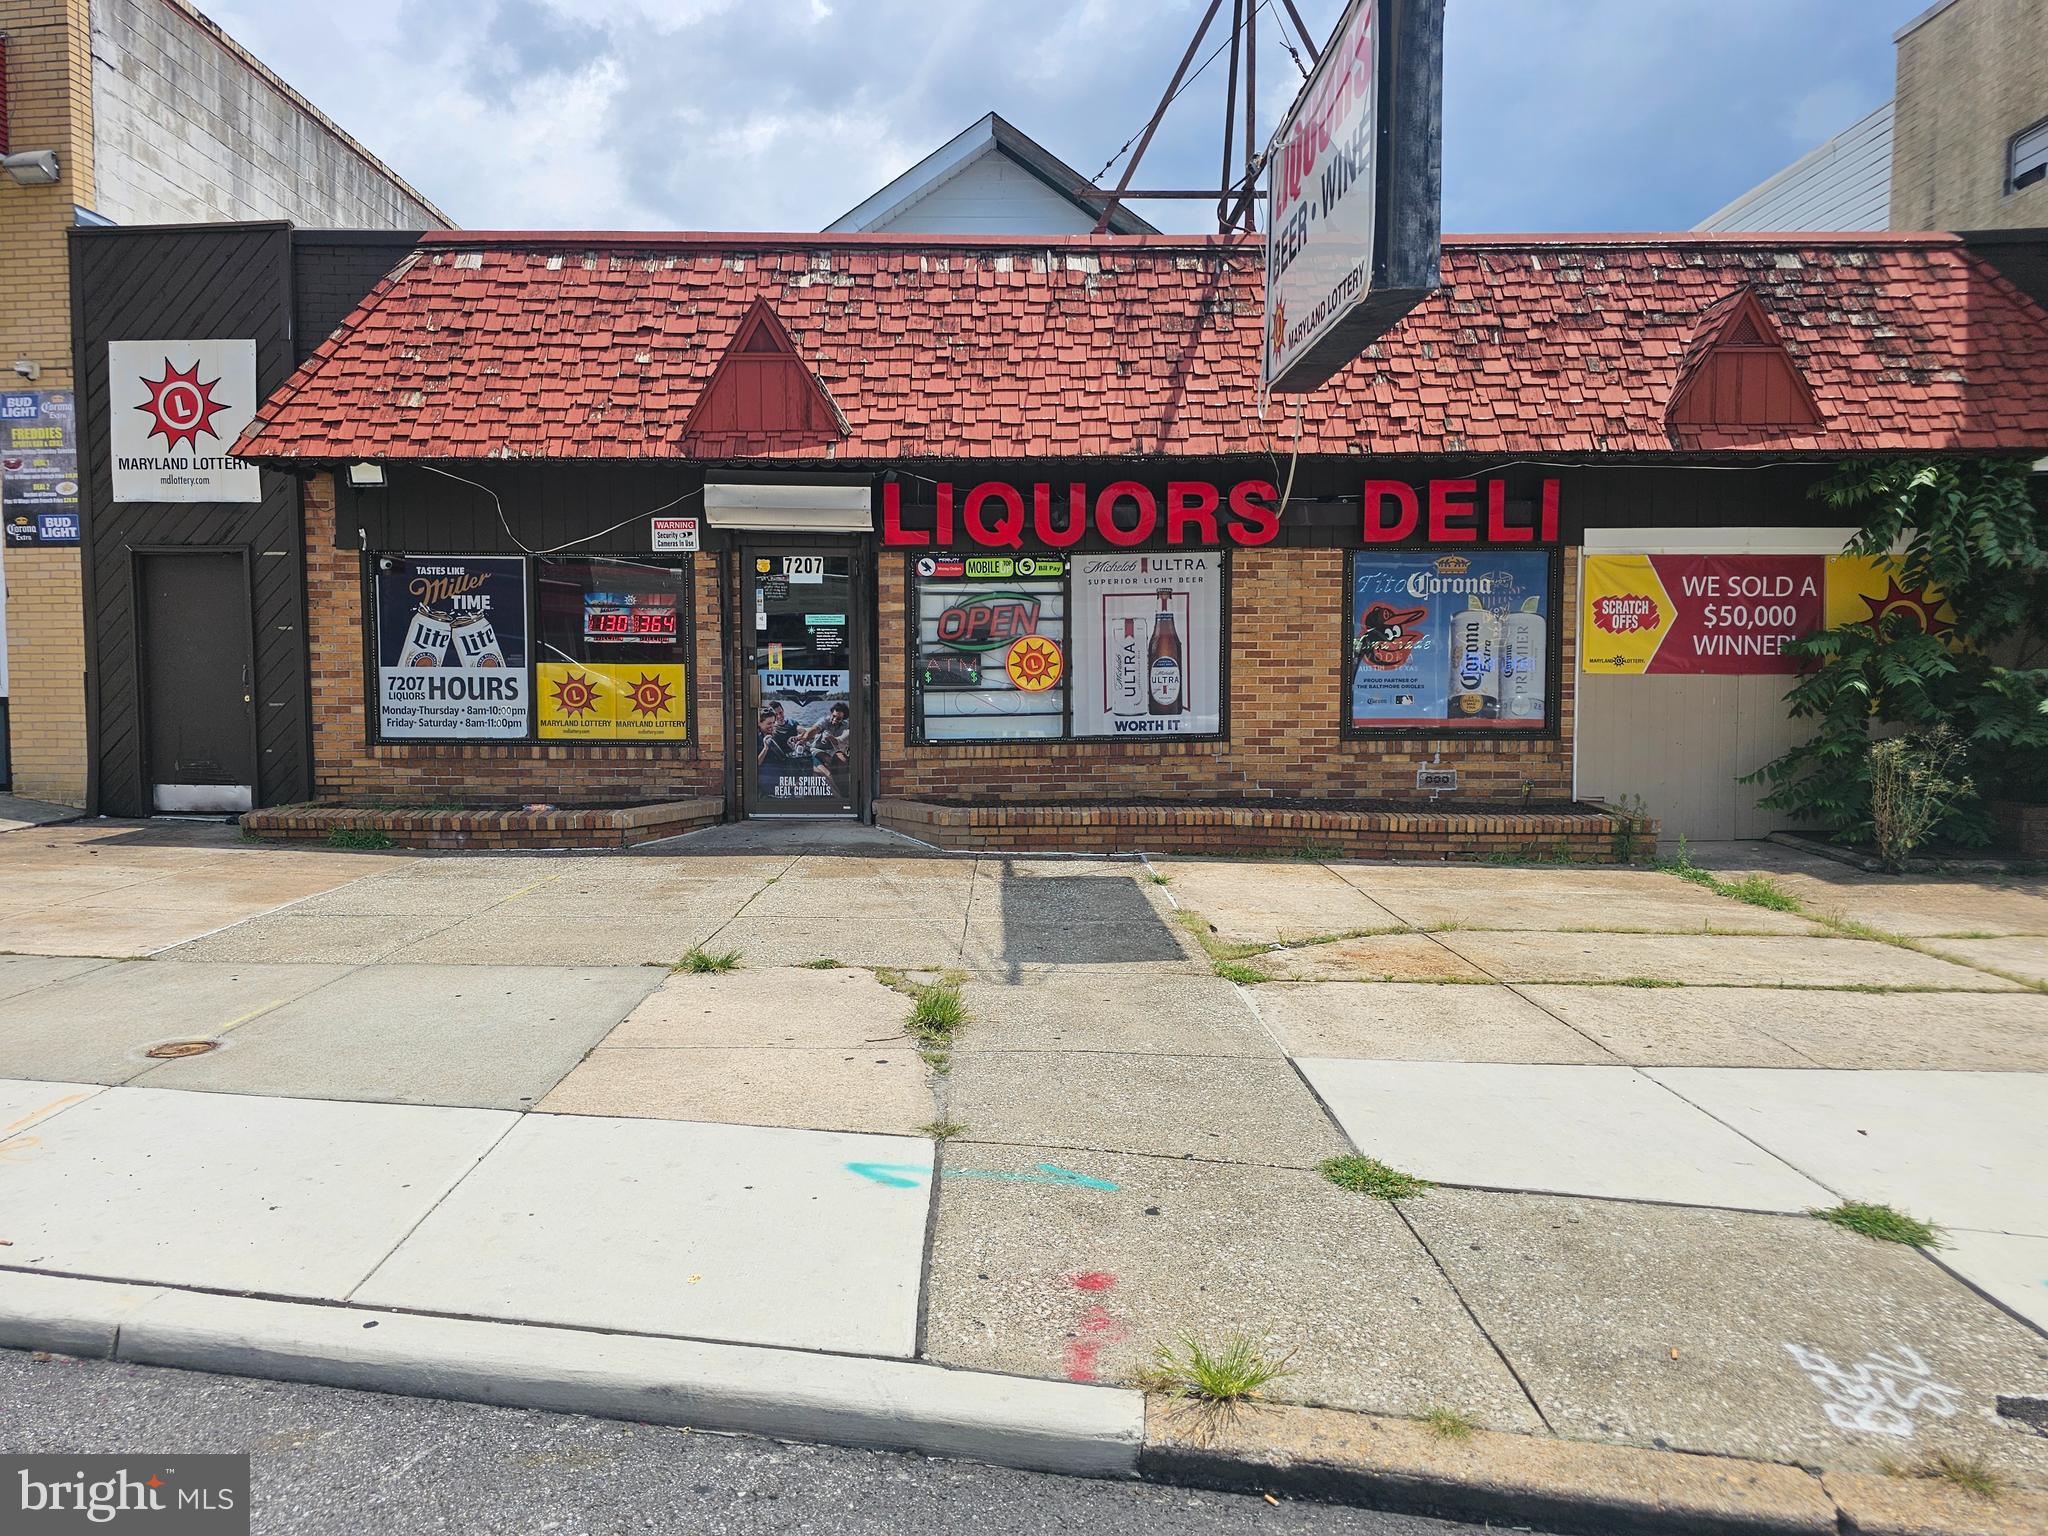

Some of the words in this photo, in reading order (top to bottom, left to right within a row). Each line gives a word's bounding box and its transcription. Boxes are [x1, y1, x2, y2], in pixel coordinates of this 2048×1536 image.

[1275, 2, 1373, 222] LIQUORS
[1273, 200, 1308, 286] BEER
[1321, 111, 1371, 219] WINE
[1288, 304, 1326, 352] MARYLAND
[1327, 261, 1365, 316] LOTTERY
[6, 397, 33, 408] BUD
[41, 401, 72, 414] Corona
[2, 407, 37, 418] LIGHT
[11, 427, 63, 440] FREDDIES
[118, 457, 188, 470] MARYLAND
[193, 457, 250, 470] LOTTERY
[160, 474, 210, 486] mdlottery.com
[883, 480, 1280, 549] LIQUORS
[1363, 479, 1560, 542] DELI
[6, 523, 37, 535] Corona
[45, 517, 71, 528] BUD
[655, 521, 695, 529] WARNING
[41, 527, 77, 538] LIGHT
[657, 531, 678, 540] Security
[416, 566, 446, 575] TASTES
[446, 566, 465, 575] LIKE
[784, 557, 823, 574] 7207
[968, 560, 1000, 574] MOBILE
[1083, 560, 1138, 574] Michelob
[1152, 559, 1206, 571] ULTRA
[1178, 576, 1204, 584] BEER
[1406, 571, 1493, 600] Corona
[1681, 576, 1721, 597] WE
[1727, 576, 1794, 597] SOLD
[1800, 575, 1818, 597] A
[409, 572, 492, 606] Miller
[451, 595, 491, 610] TIME
[1602, 600, 1649, 615] SCRATCH
[600, 615, 628, 632] 130
[640, 615, 674, 632] 364
[937, 601, 1041, 641] OPEN
[1611, 614, 1639, 629] OFFS
[1703, 603, 1797, 630] $50,000
[413, 623, 450, 650] Lite
[460, 624, 493, 657] Lite
[1460, 622, 1482, 690] Corona
[1480, 639, 1492, 673] Extra
[1504, 643, 1514, 678] Corona
[1515, 625, 1529, 694] PREMIER
[925, 657, 977, 672] ATM
[1124, 643, 1136, 697] ULTRA
[387, 676, 425, 691] 7207
[766, 674, 839, 687] CUTWATER
[1151, 676, 1179, 684] ULTRA
[428, 676, 519, 701] HOURS
[388, 692, 426, 701] LIQUORS
[382, 705, 459, 717] Monday-Thursday
[466, 706, 526, 716] 8am-10:00pm
[386, 718, 417, 729] Friday-
[419, 718, 458, 729] Saturday
[465, 718, 522, 729] 8am-11:00pm
[540, 719, 579, 727] MARYLAND
[580, 719, 611, 727] LOTTERY
[616, 720, 653, 728] MARYLAND
[655, 720, 686, 728] LOTTERY
[1114, 720, 1164, 732] WORTH
[1167, 720, 1181, 731] IT
[779, 776, 796, 787] REAL
[799, 776, 828, 787] SPIRITS.
[774, 786, 792, 796] REAL
[794, 786, 833, 796] COCKTAILS.
